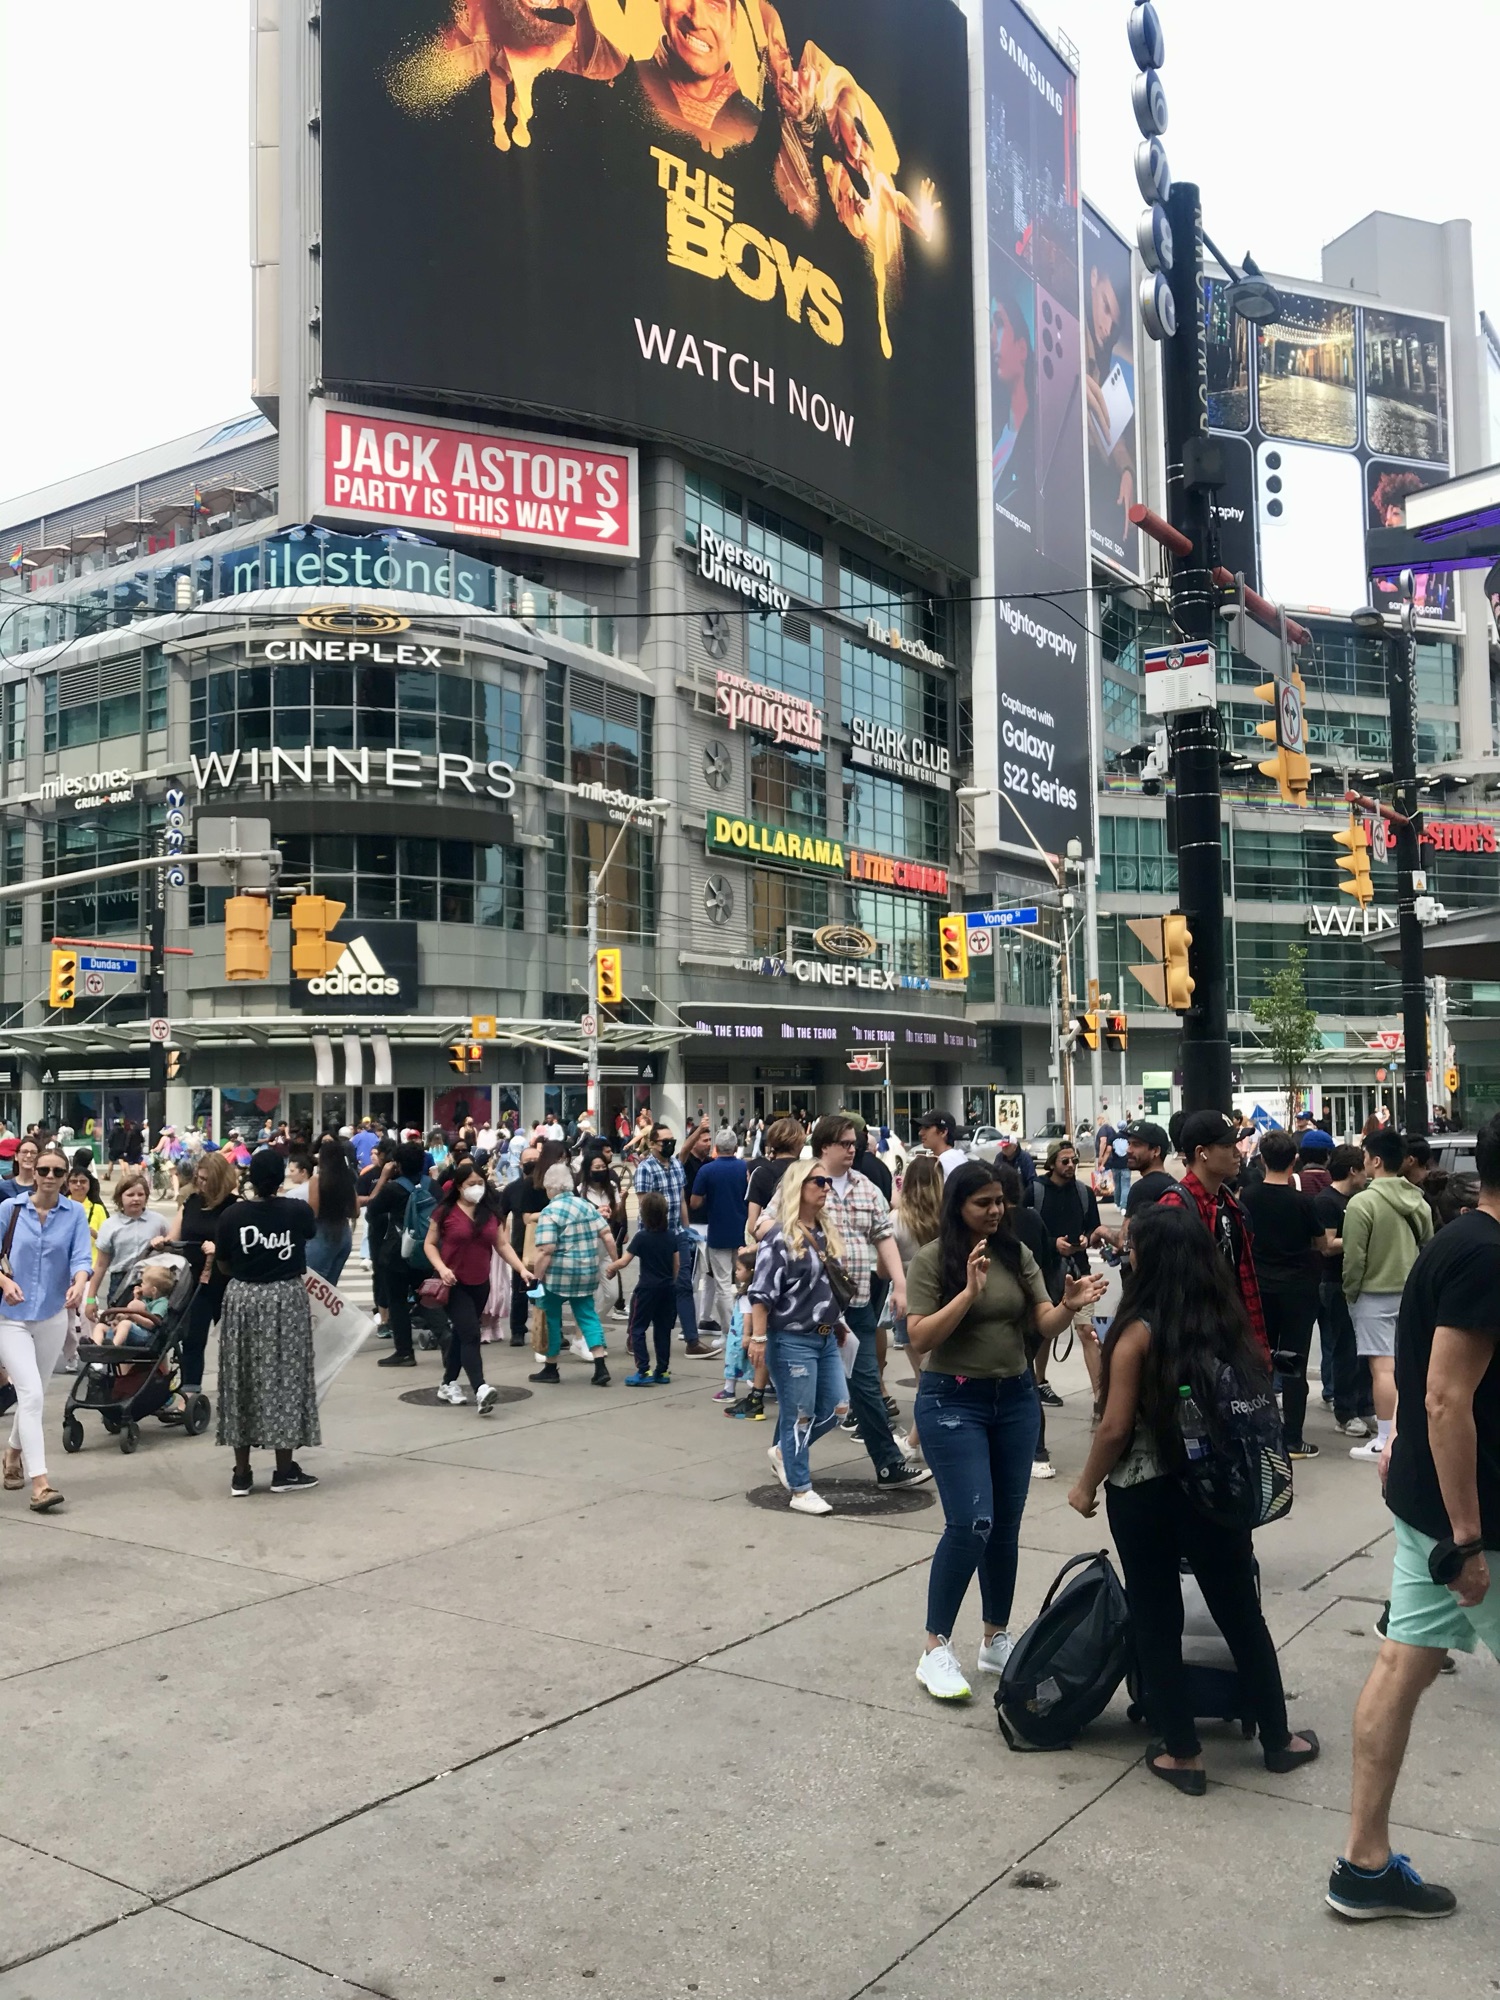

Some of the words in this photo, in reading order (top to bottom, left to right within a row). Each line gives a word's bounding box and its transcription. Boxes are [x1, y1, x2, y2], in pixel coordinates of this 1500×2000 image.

[1000, 25, 1063, 116] SAMSUNG
[650, 145, 734, 222] THE
[667, 197, 844, 346] BOYS
[634, 317, 775, 405] WATCH
[788, 377, 855, 447] NOW
[334, 424, 440, 484] JACK
[452, 443, 619, 509] ASTOR'S
[334, 474, 417, 513] PARTY
[424, 487, 448, 516] IS
[453, 491, 509, 526] THIS
[516, 500, 570, 533] WAY
[996, 503, 1031, 533] samsung.com
[700, 523, 773, 580] Ryerson
[233, 542, 475, 603] milestones
[700, 550, 791, 617] University
[1000, 599, 1077, 664] Nightography
[264, 640, 442, 668] CINEPLEX
[1001, 692, 1036, 718] Captured
[1036, 708, 1055, 728] with
[852, 716, 907, 761] SHARK
[912, 738, 950, 774] CLUB
[1002, 720, 1055, 771] Galaxy
[1308, 727, 1345, 743] DMZ
[190, 745, 516, 799] WINNERS
[873, 753, 902, 776] SPORTS
[904, 762, 919, 779] BAR
[75, 796, 105, 811] GRILL
[110, 790, 132, 804] BAR
[1003, 761, 1030, 795] S22
[1031, 774, 1078, 811] Series
[637, 816, 653, 828] BAR
[715, 816, 845, 868] DOLLARAMA
[851, 850, 894, 884] LITTLE
[893, 861, 947, 895] CANADA
[983, 912, 1013, 925] Yonge
[90, 958, 121, 971] Dundas
[795, 959, 895, 991] CINEPLEX
[307, 972, 400, 996] adidas
[902, 975, 931, 991] IMAX
[714, 1024, 732, 1038] THE
[734, 1024, 763, 1038] TENOR
[797, 1026, 812, 1039] THE
[813, 1027, 837, 1040] TENOR
[863, 1029, 876, 1041] THE
[877, 1029, 895, 1042] TENOR
[923, 1033, 937, 1045] TENOR
[239, 1225, 296, 1260] Pray
